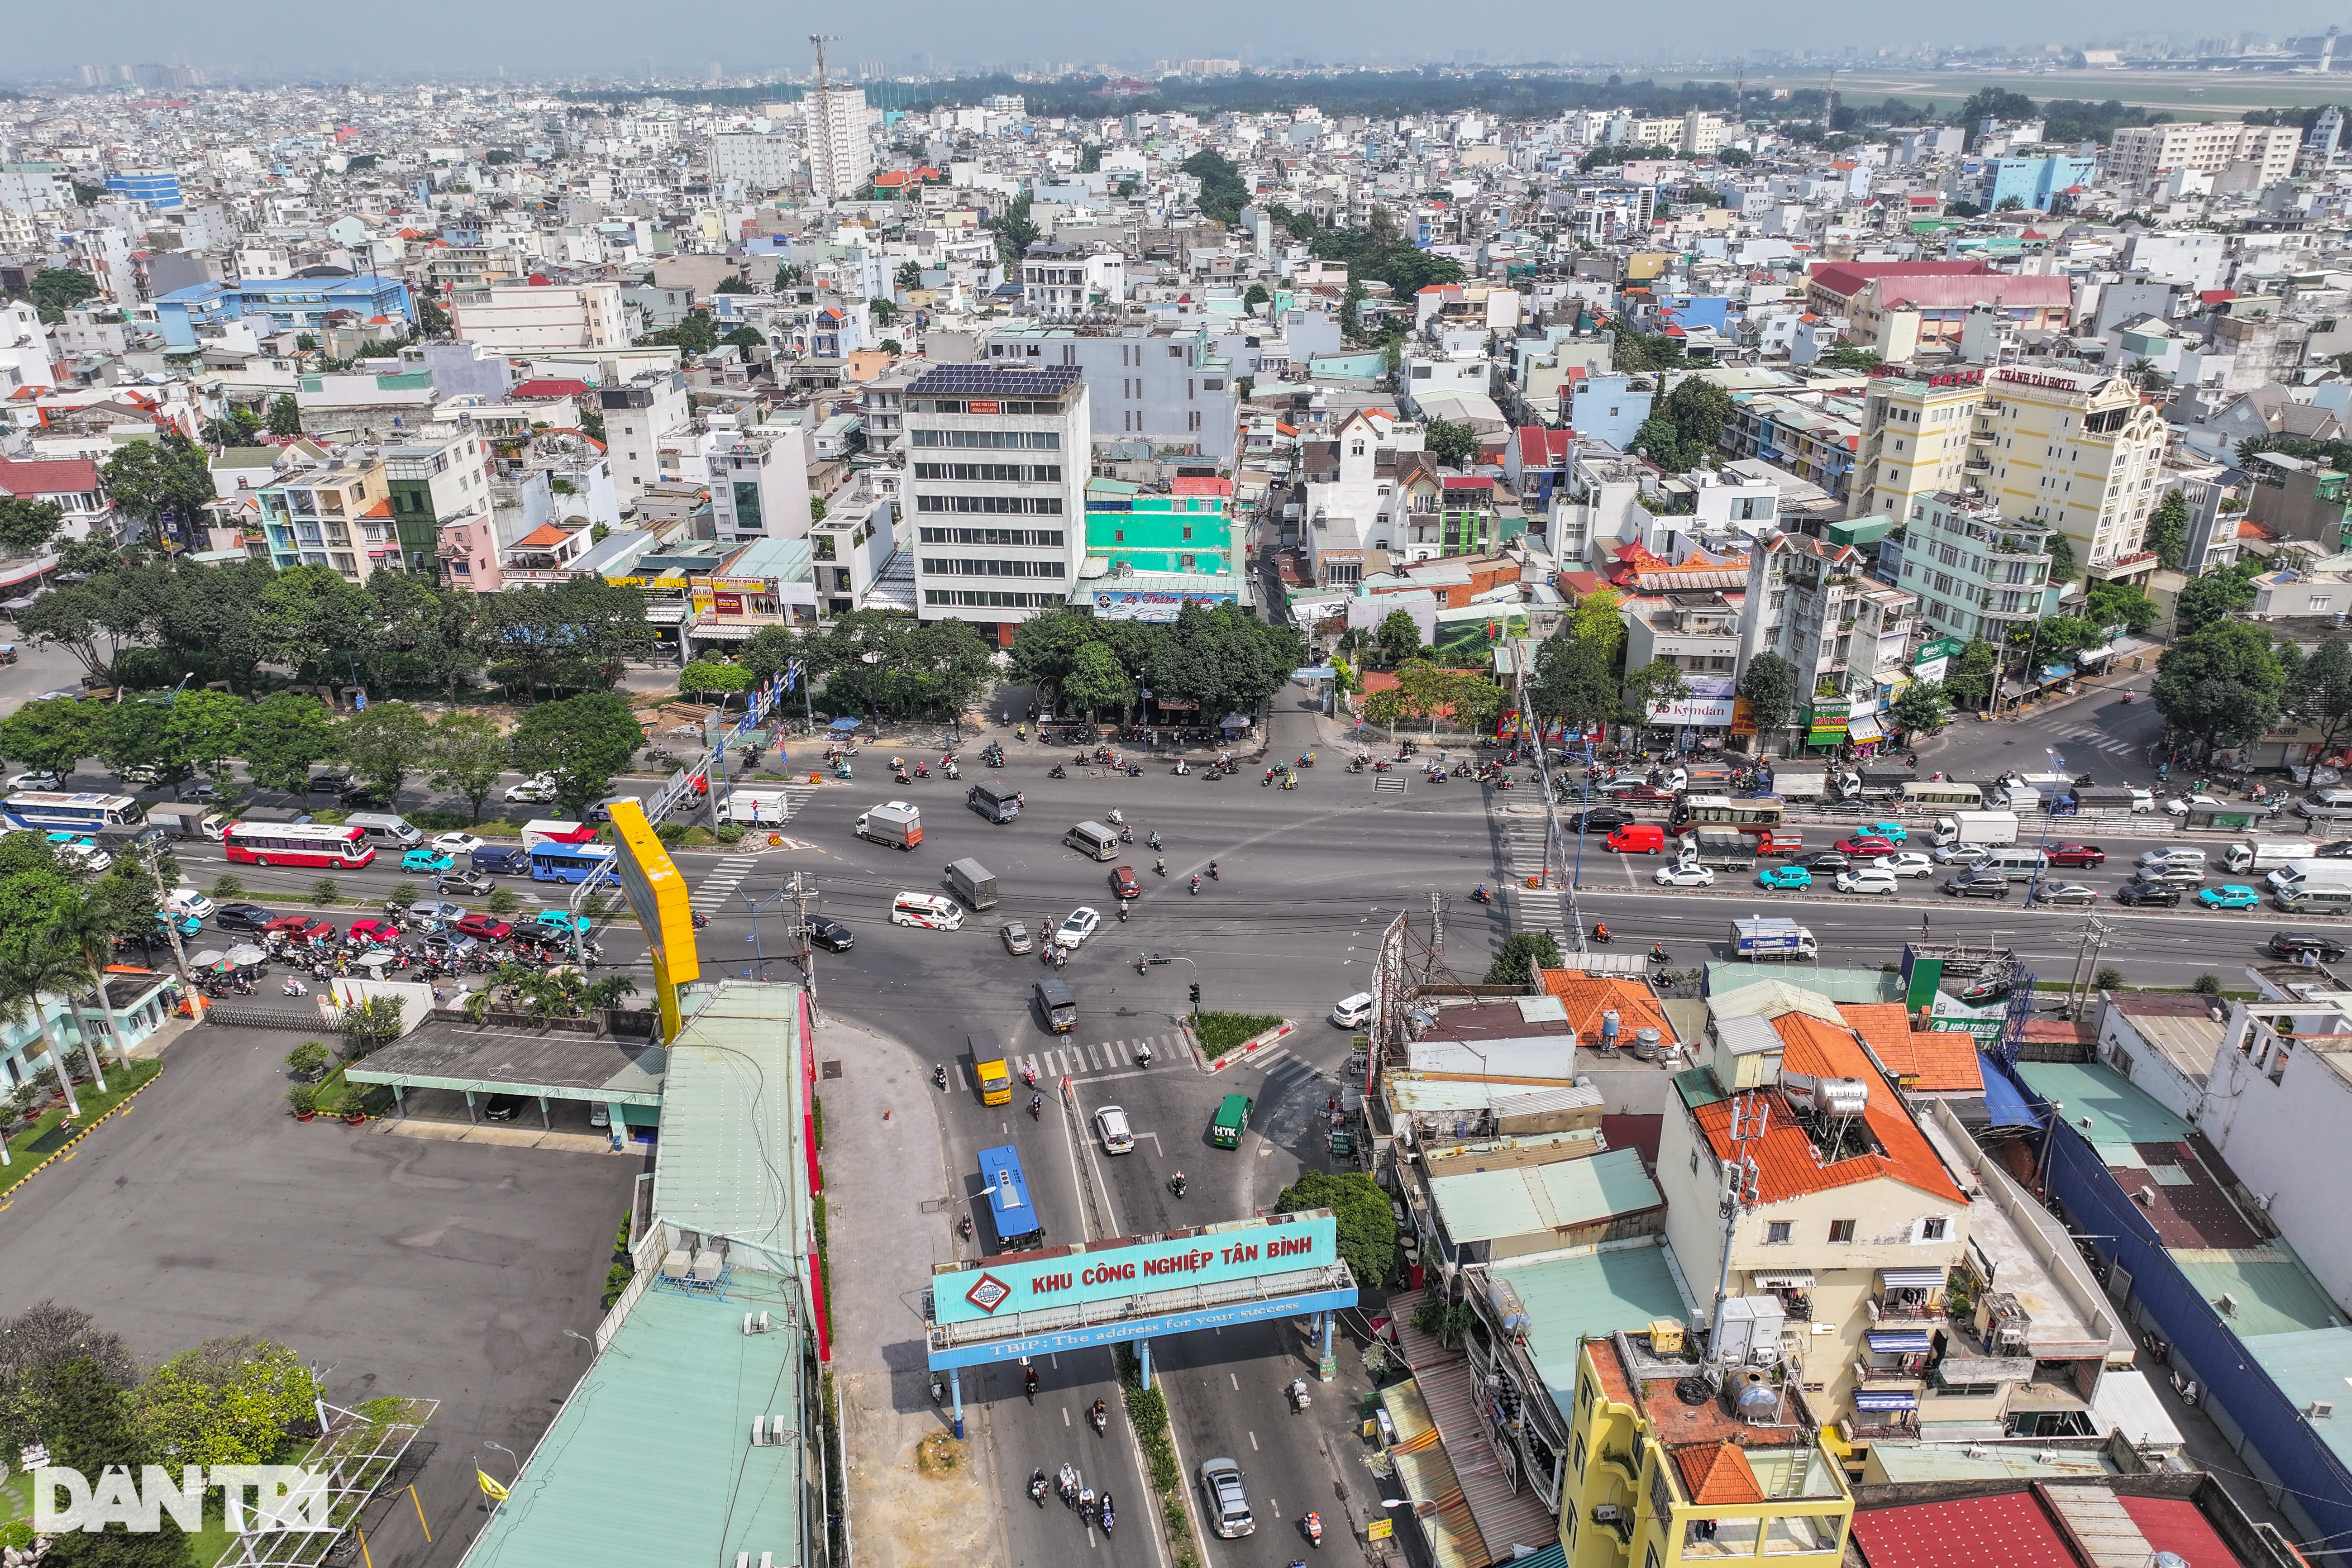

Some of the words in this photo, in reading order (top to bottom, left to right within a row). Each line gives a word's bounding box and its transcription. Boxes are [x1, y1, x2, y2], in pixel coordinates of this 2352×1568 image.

[1928, 369, 1985, 388] HOTEL
[2048, 377, 2077, 392] HOTEL
[730, 445, 753, 455] ATA
[604, 577, 646, 586] HAPPY
[653, 577, 688, 587] ZONE
[1120, 594, 1139, 605] Lộ
[1142, 594, 1179, 604] Thiên
[1182, 594, 1214, 605] Quán
[1674, 705, 1724, 716] Kymdan
[1814, 714, 1830, 724] HẢI
[1831, 715, 1848, 725] SƠN
[1948, 1021, 1969, 1031] HẢI
[1032, 1272, 1072, 1294] KHU
[1082, 1261, 1135, 1285] CÔNG
[1143, 1248, 1214, 1277] NGHIỆP
[1221, 1241, 1258, 1264] TÂN
[1266, 1234, 1312, 1258] BÌNH
[1051, 1332, 1090, 1347] The
[1095, 1323, 1159, 1341] address
[1164, 1314, 1191, 1330] for
[1195, 1311, 1234, 1330] your
[1239, 1301, 1299, 1319] success
